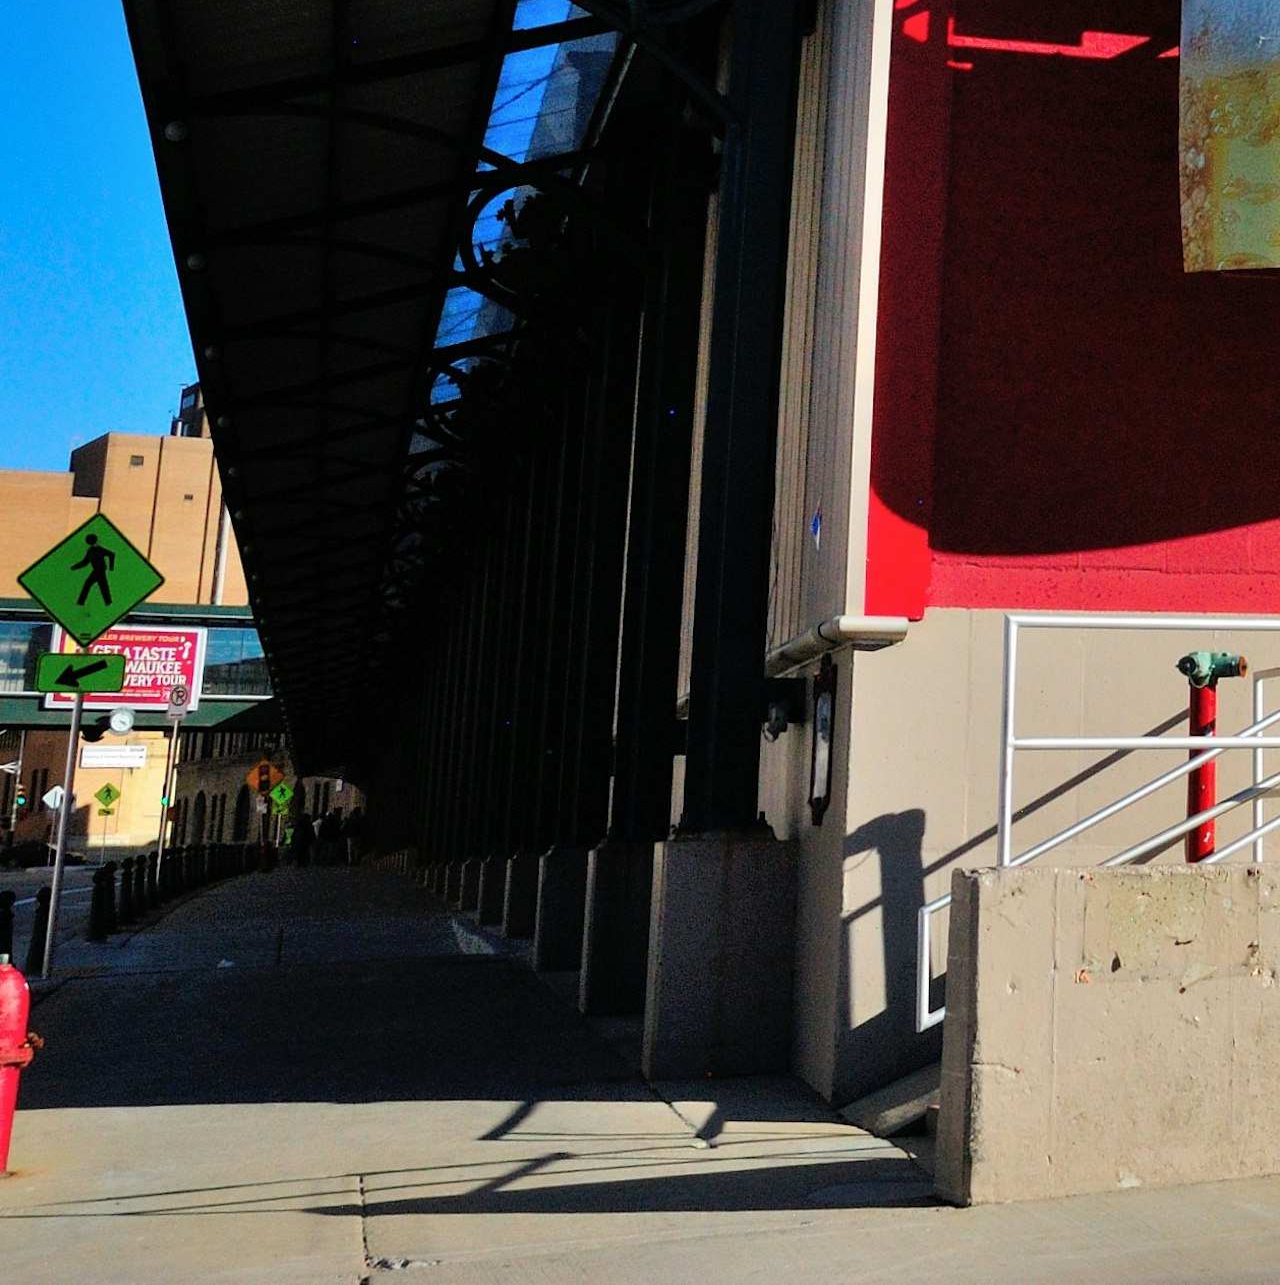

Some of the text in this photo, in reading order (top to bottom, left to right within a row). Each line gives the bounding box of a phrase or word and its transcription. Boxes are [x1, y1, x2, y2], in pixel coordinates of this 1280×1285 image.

[98, 632, 119, 642] LLER
[158, 635, 181, 643] TOUR
[123, 646, 132, 660] A
[133, 646, 177, 662] TASTE
[125, 661, 183, 675] WAUKEE
[156, 675, 187, 686] TOUR
